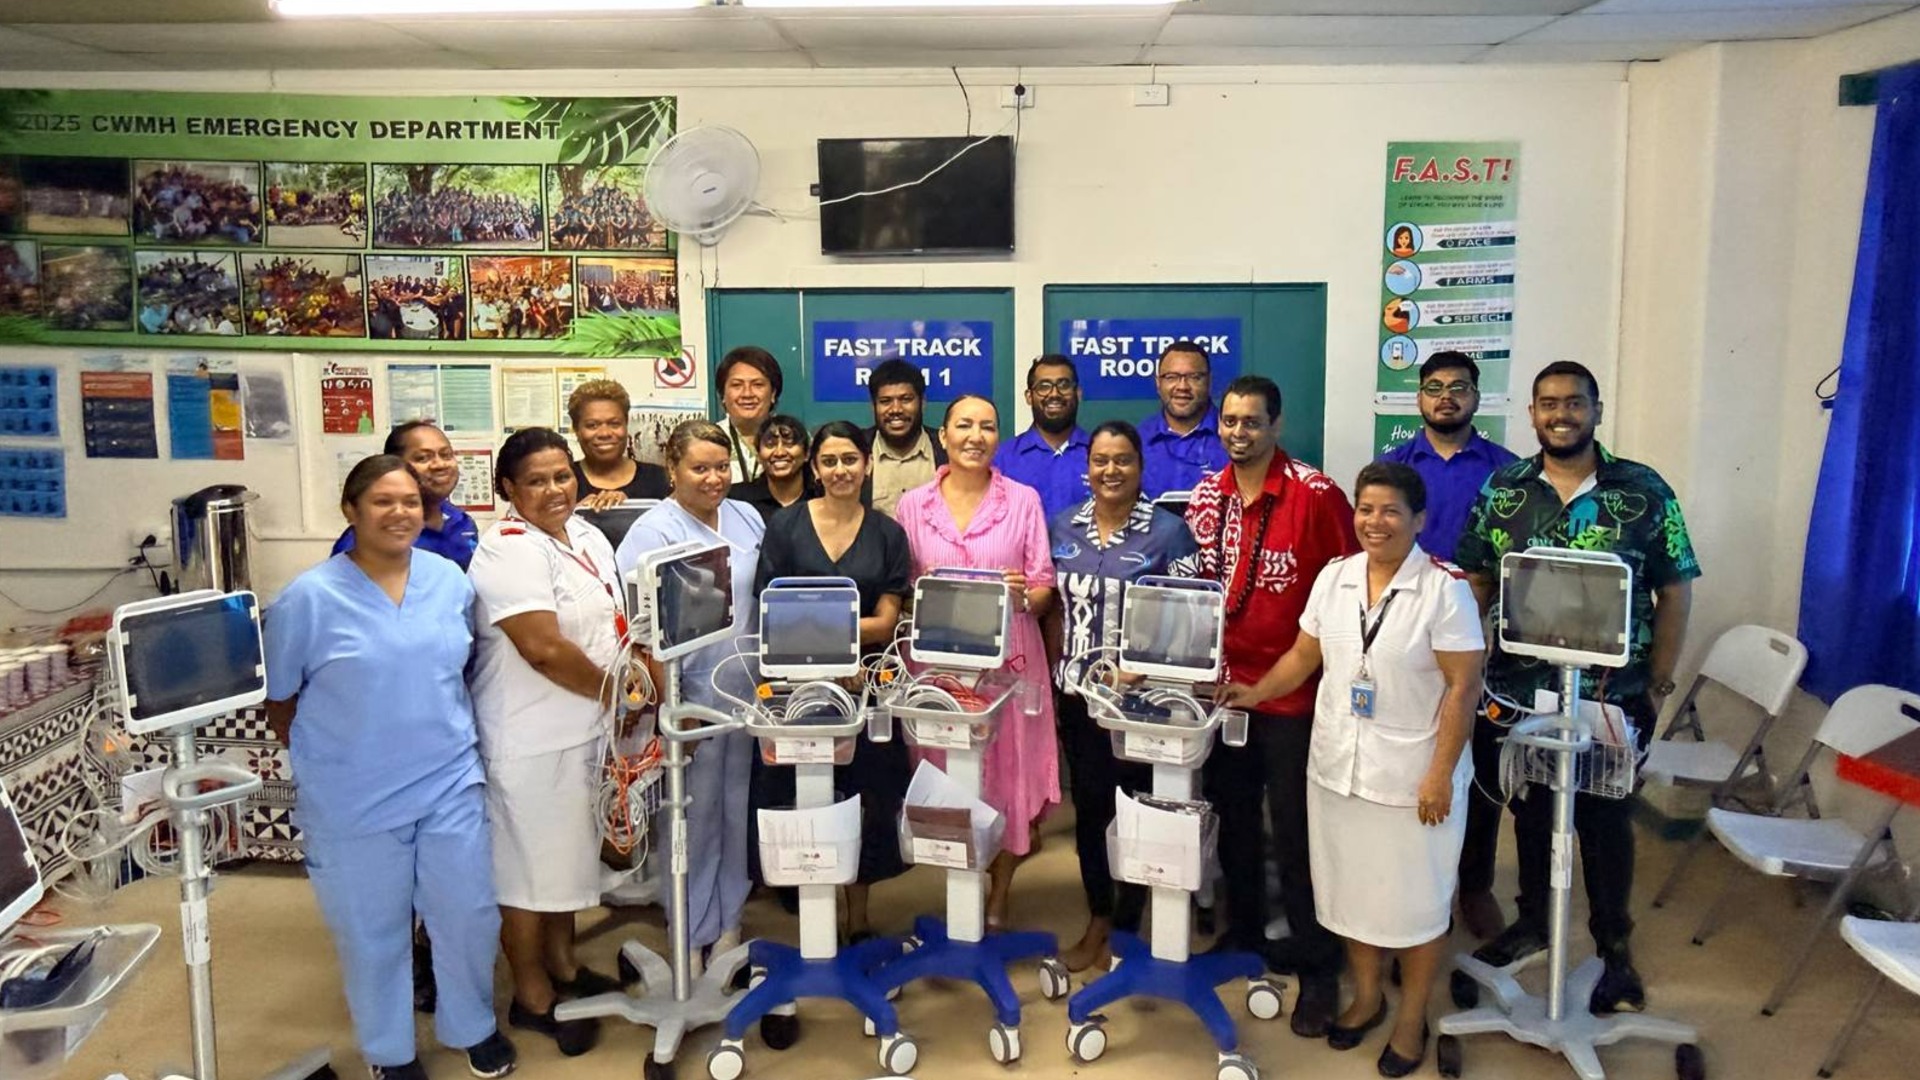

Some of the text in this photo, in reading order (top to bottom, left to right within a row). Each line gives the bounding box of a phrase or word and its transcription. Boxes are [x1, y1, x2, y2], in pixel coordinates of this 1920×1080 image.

[16, 113, 561, 140] 2025 CWMH EMERGENCY DEPARTMENT
[1392, 156, 1514, 182] F.A.S.T!
[1457, 238, 1491, 248] FACE
[1456, 276, 1495, 286] ARMS
[1454, 313, 1506, 324] SPEECH
[824, 338, 982, 357] FAST TRACK
[1071, 335, 1229, 355] FAST TRCK
[1100, 358, 1160, 377] ROO
[939, 368, 951, 386] 1
[1391, 424, 1416, 441] How
